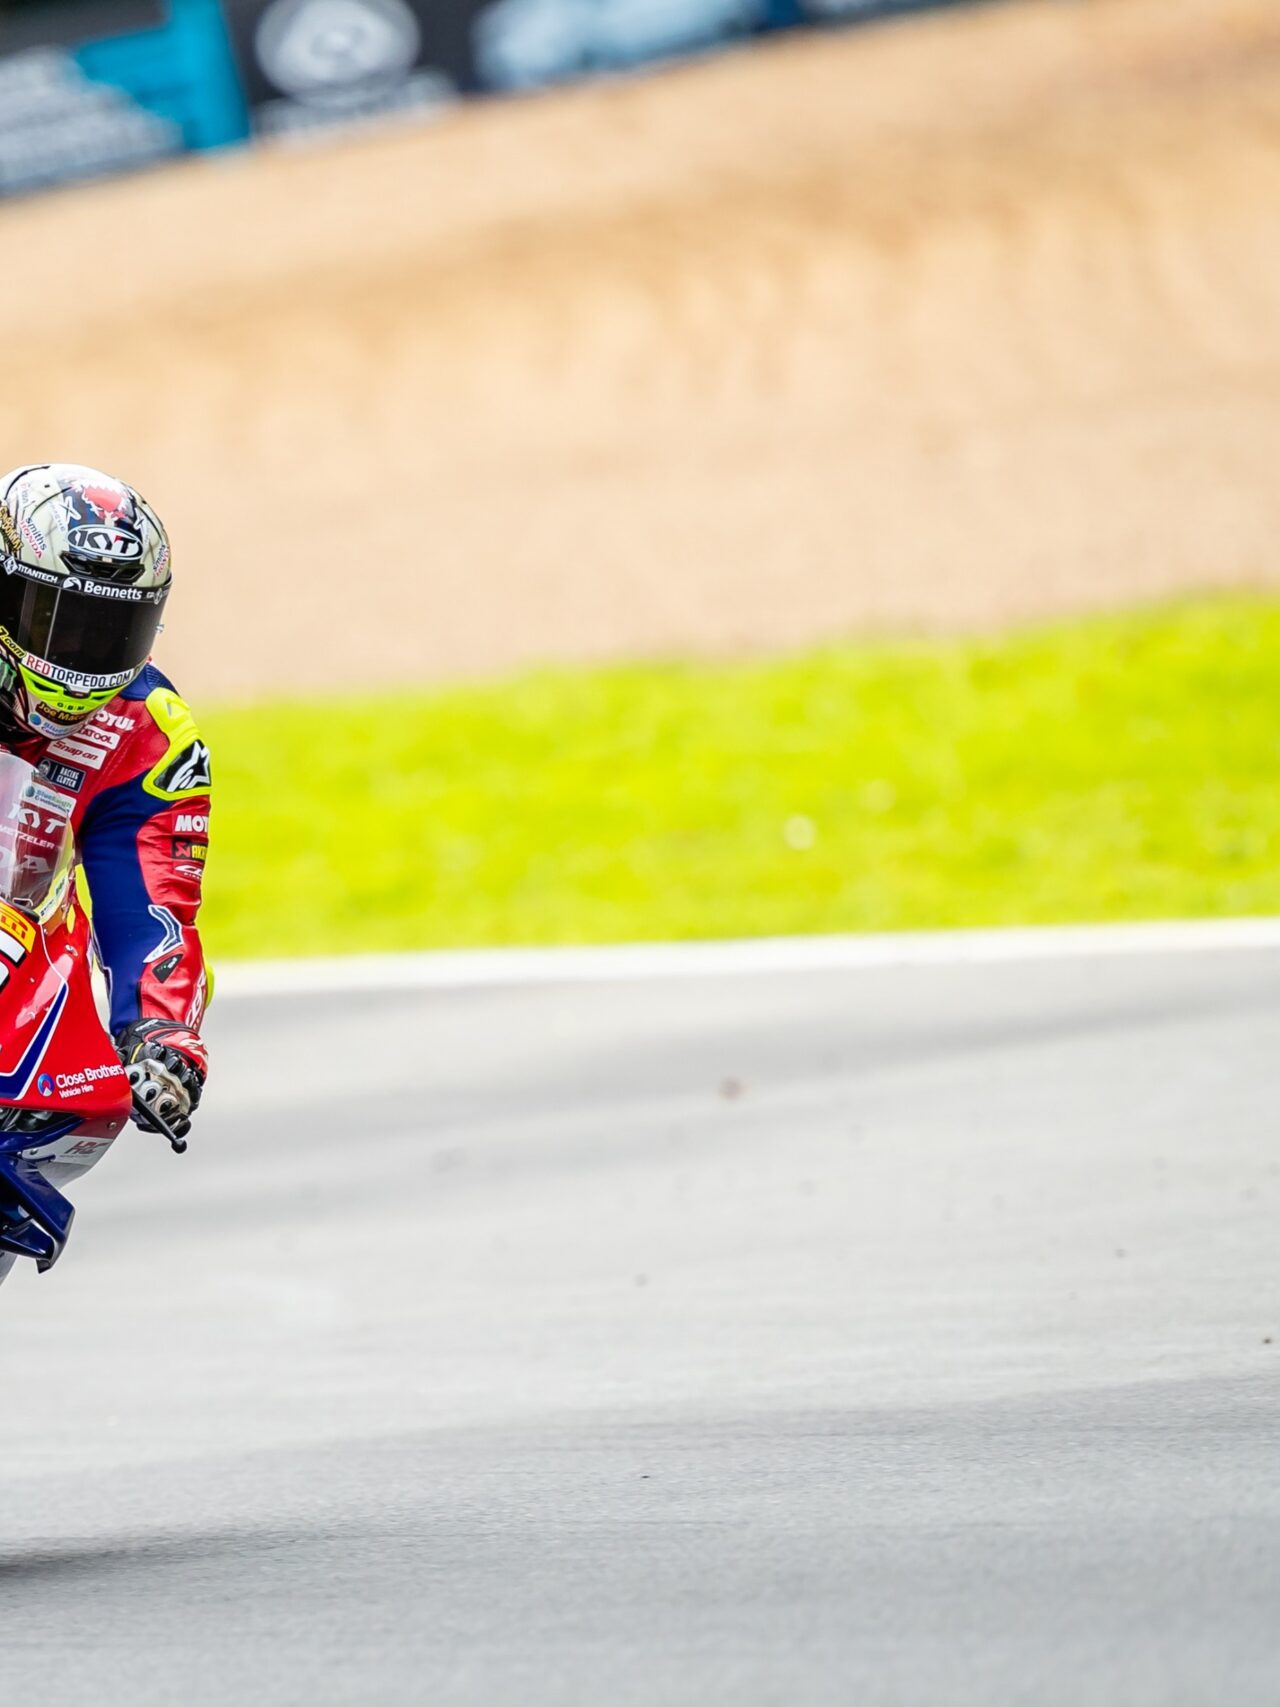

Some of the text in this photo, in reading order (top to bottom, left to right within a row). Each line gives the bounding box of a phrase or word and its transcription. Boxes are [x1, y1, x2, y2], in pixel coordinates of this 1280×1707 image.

[26, 517, 47, 551] smiths
[77, 530, 137, 555] KYT
[17, 564, 59, 584] TITANTECH
[83, 579, 143, 601] Bennetts
[26, 654, 132, 689] REDTORPEDO.COM
[56, 775, 77, 789] CLUTCH
[60, 766, 80, 780] RACING
[174, 814, 208, 833] MOT
[55, 1064, 125, 1089] Close Brothers
[58, 1084, 95, 1099] Vehicle Hire
